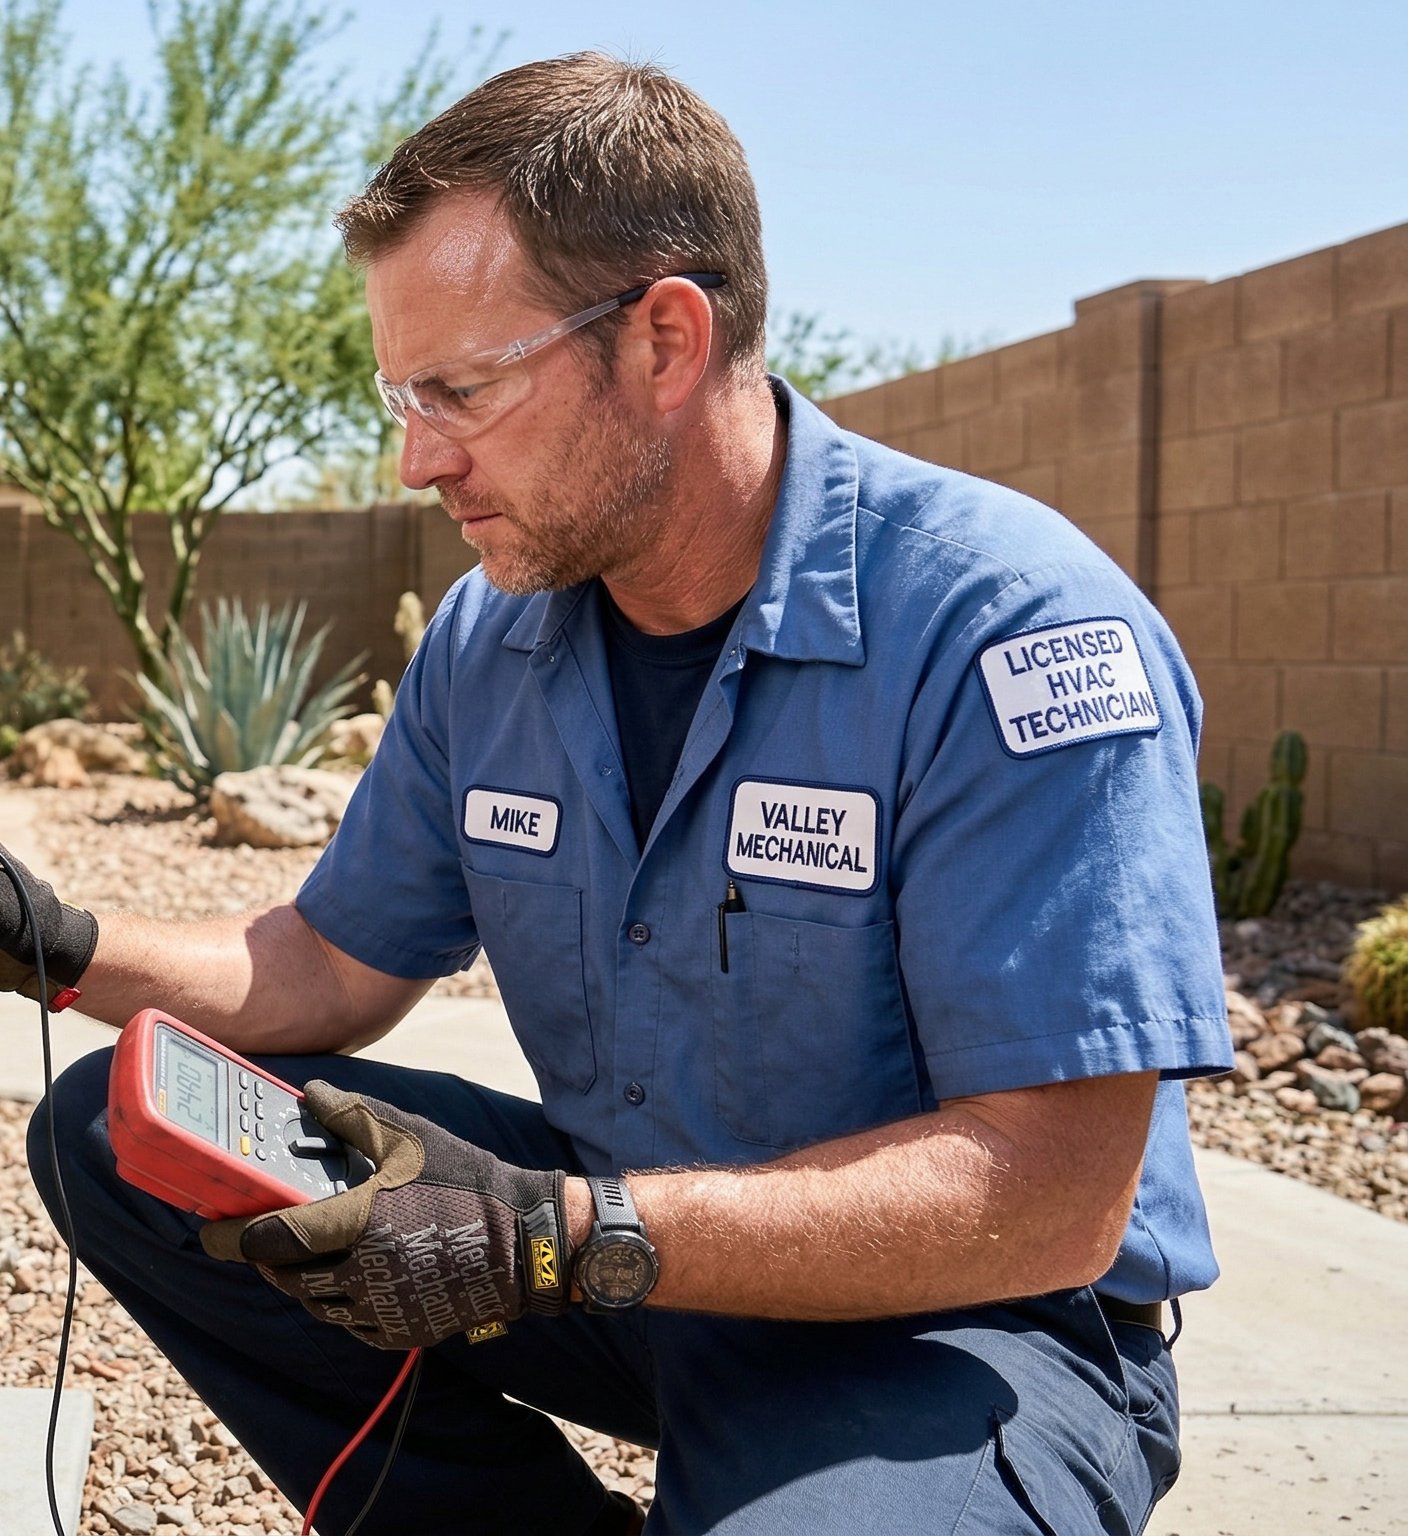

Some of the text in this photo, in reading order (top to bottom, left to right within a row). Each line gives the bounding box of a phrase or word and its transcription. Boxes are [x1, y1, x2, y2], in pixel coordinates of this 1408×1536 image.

[1003, 628, 1123, 677] LICENSED
[1046, 661, 1116, 700] HVAC
[1008, 690, 1156, 744] TECHNICIAN
[490, 805, 541, 838] MIKE
[760, 800, 848, 836] VALLEY
[735, 831, 868, 873] MECHANICAL
